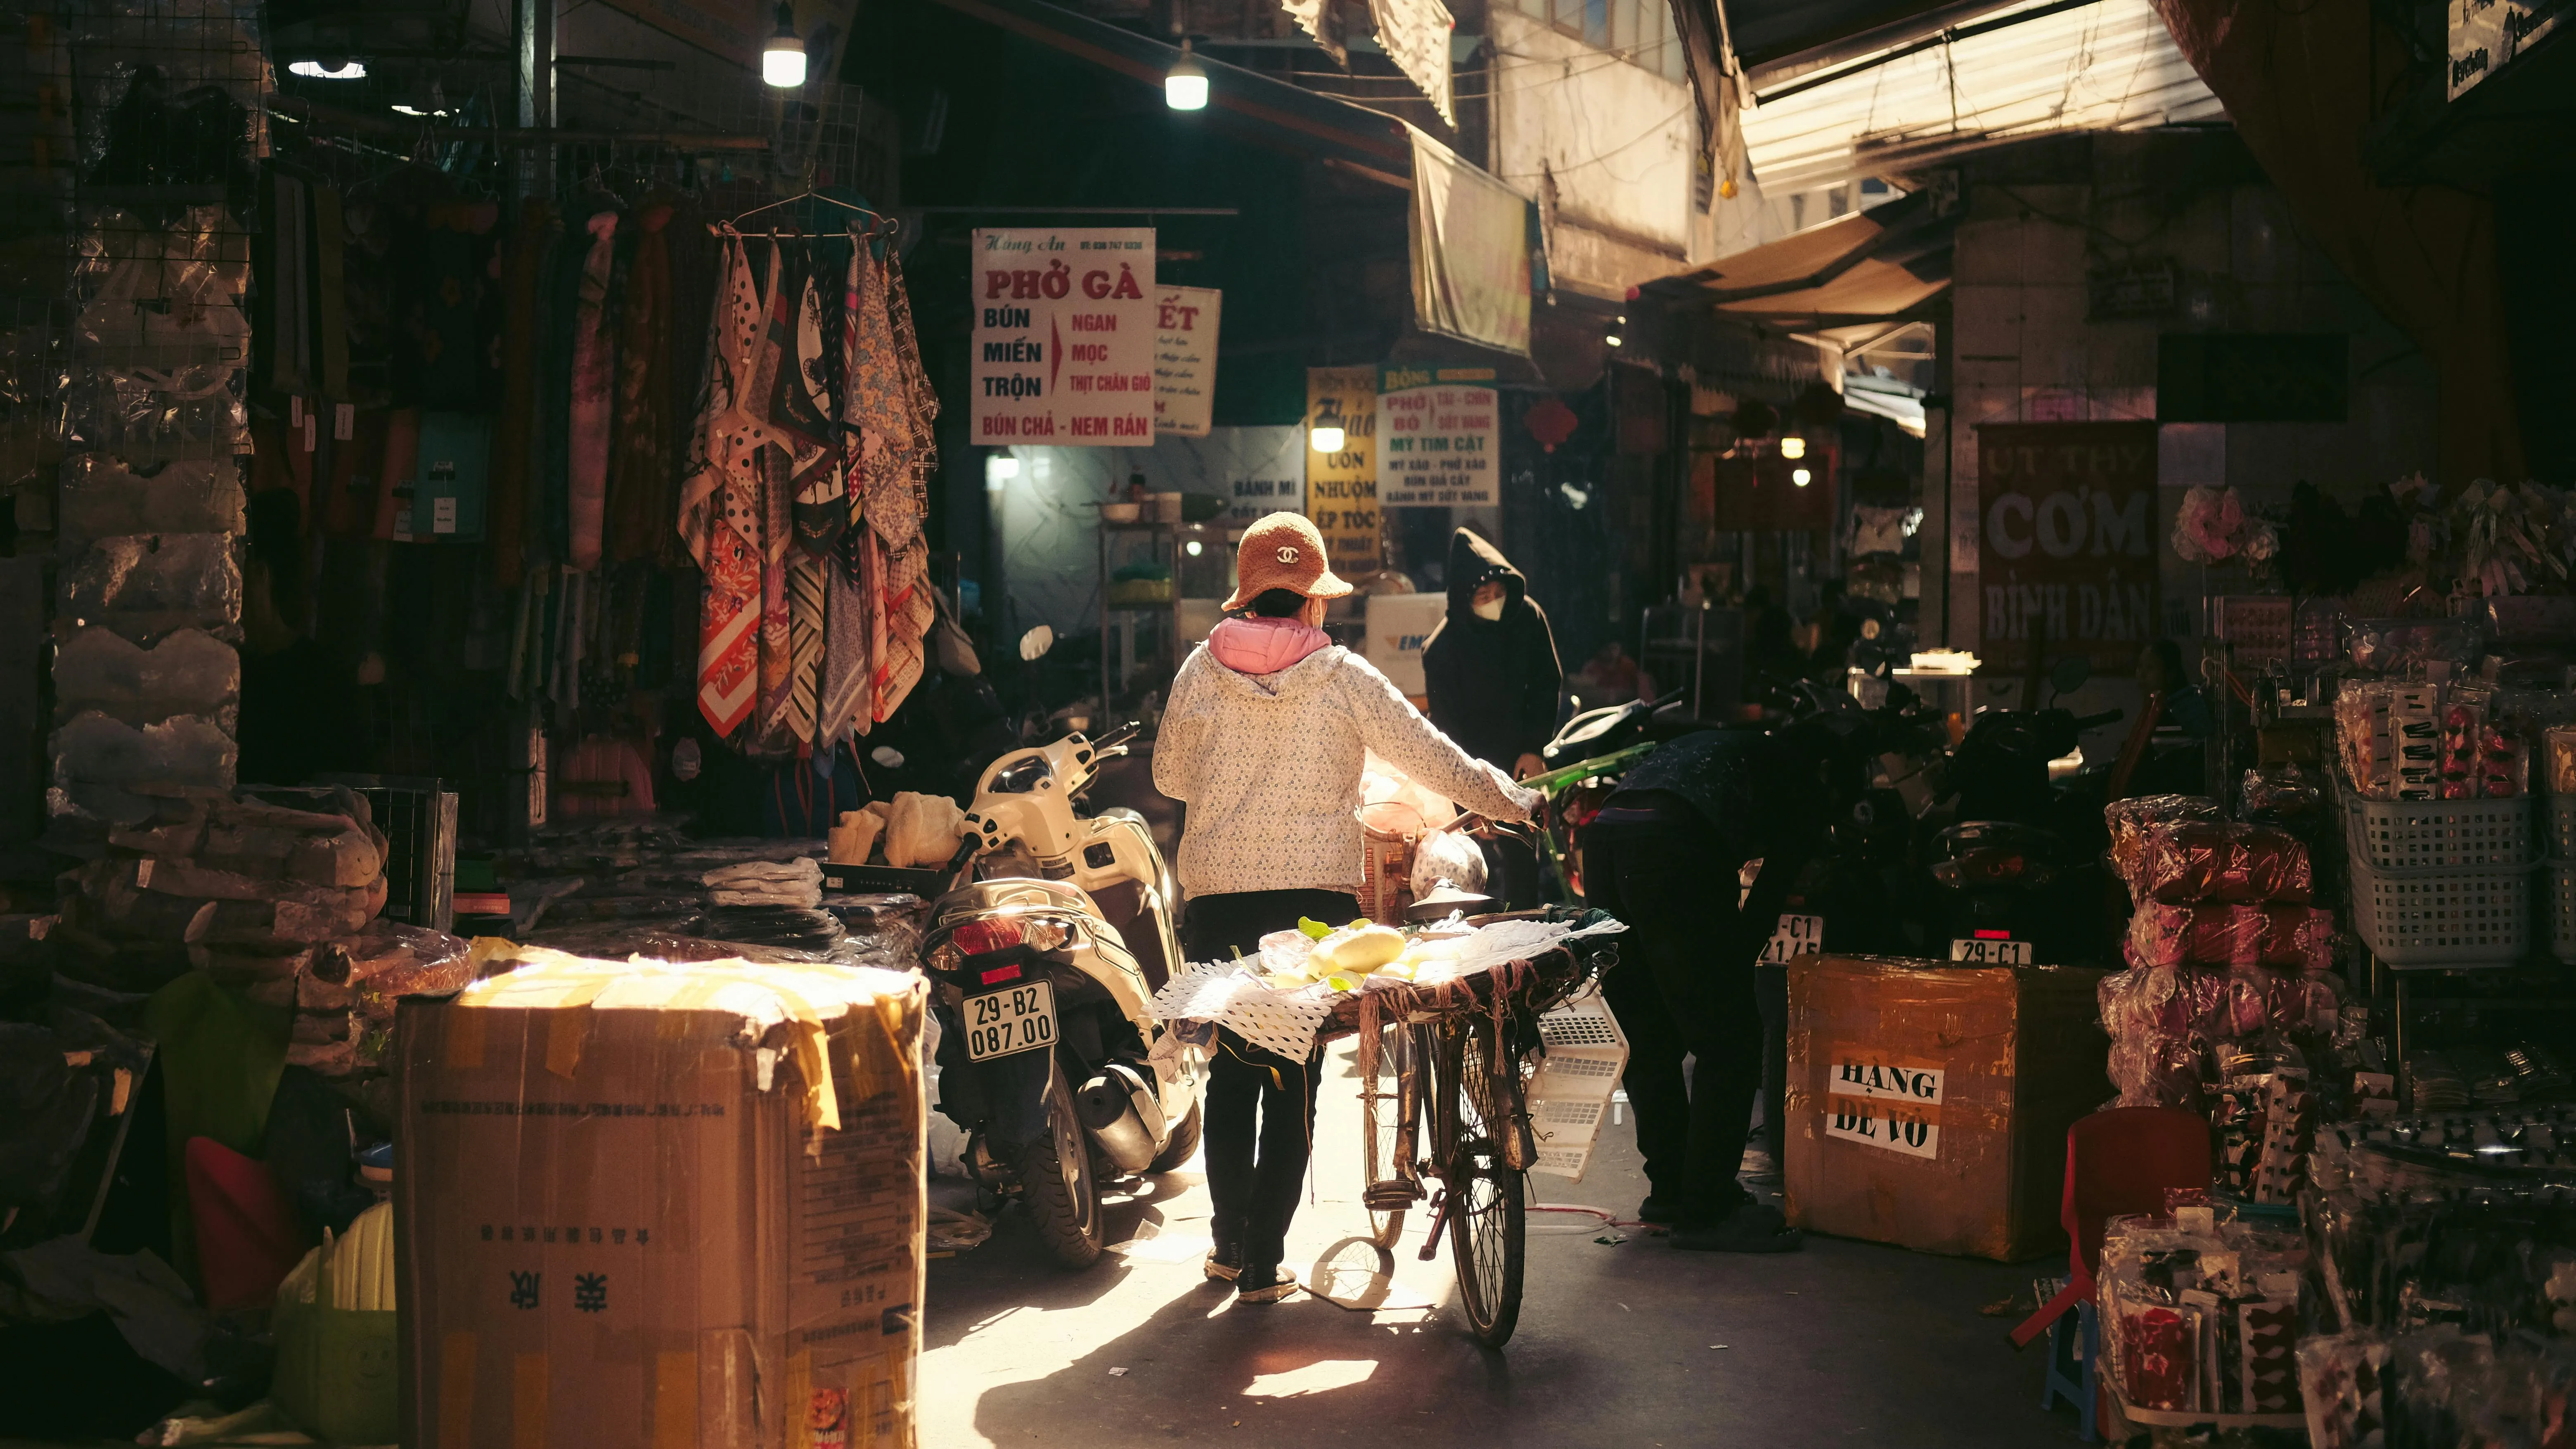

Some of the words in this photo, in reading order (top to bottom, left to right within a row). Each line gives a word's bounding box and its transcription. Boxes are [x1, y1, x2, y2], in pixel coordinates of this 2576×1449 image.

[986, 258, 1070, 299] PHỞ
[1082, 262, 1143, 299] GÀ
[984, 304, 1030, 328] BÚN
[1072, 314, 1117, 331] NGAN
[1157, 294, 1200, 331] ẾT
[983, 336, 1041, 362] MIẾN
[1072, 344, 1108, 366] MỌC
[983, 372, 1041, 401] TRỘN
[1070, 375, 1093, 395] THỊT
[983, 413, 1016, 436] BÚN
[1022, 409, 1054, 436] CHẢ
[1071, 417, 1108, 436] NEM
[1113, 412, 1147, 436] RÁN
[1327, 443, 1365, 469] UỐN
[1421, 437, 1449, 451] TIM
[1234, 478, 1274, 496] BÁNH
[1986, 484, 2150, 559] CƠM
[1985, 566, 2069, 639] BÌNH
[2077, 566, 2152, 640] DÂN
[1398, 634, 1428, 650] EM
[1771, 917, 1811, 940] -C1
[1962, 942, 2020, 964] 29-C1
[974, 987, 1040, 1025] 29-B2
[971, 1014, 1051, 1056] 087.00
[1839, 1056, 1937, 1099] HÀNG
